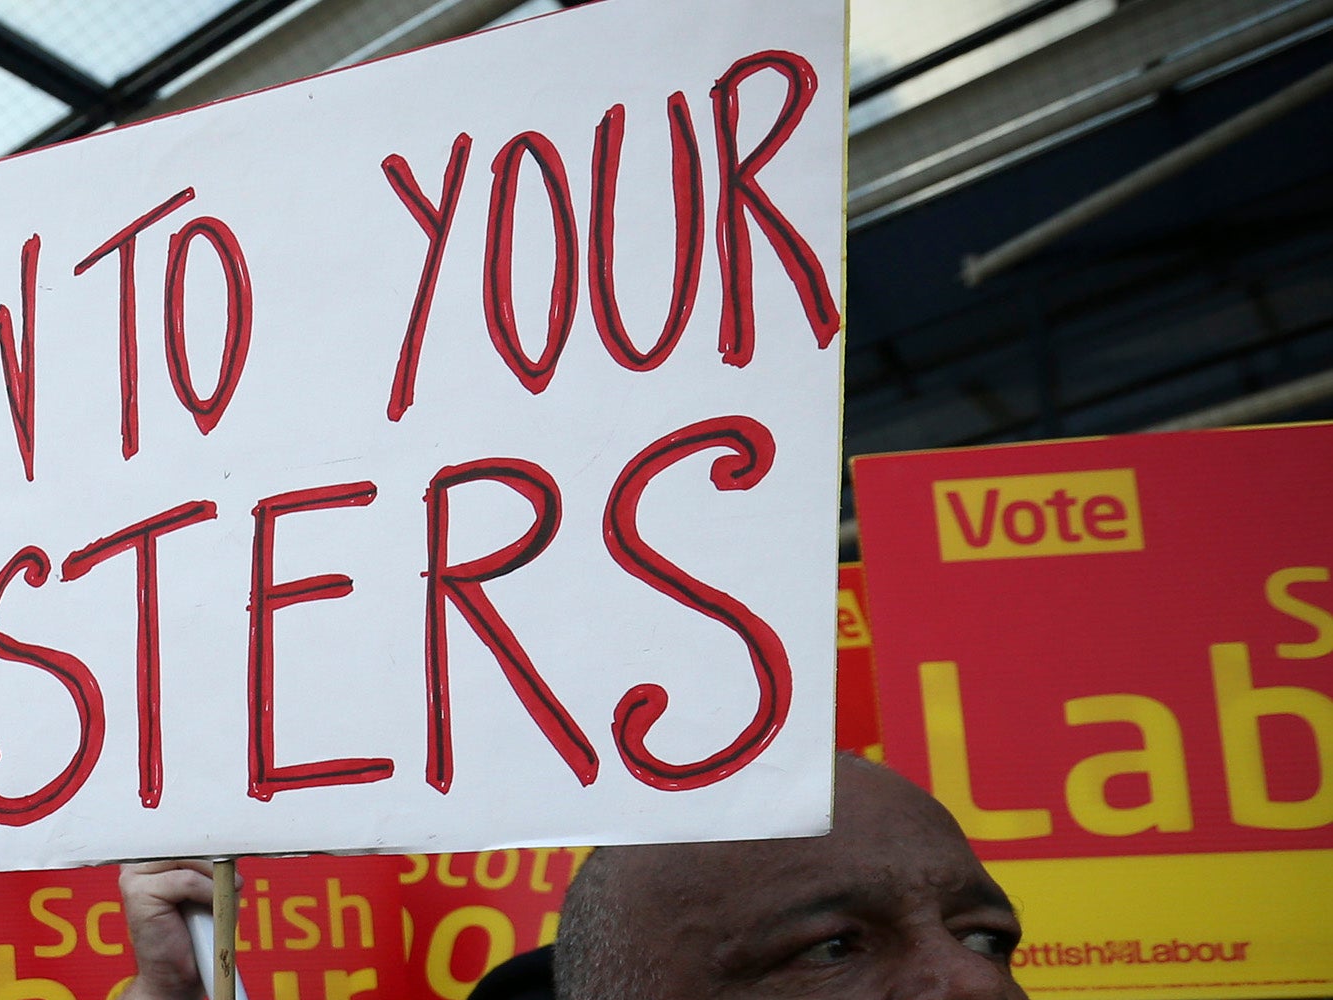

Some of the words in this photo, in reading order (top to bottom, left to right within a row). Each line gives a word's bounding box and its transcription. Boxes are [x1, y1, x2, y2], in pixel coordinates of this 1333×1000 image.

[74, 187, 253, 460] TO
[381, 50, 842, 422] YOUR
[945, 487, 1129, 549] Vote
[918, 641, 1333, 842] Lab
